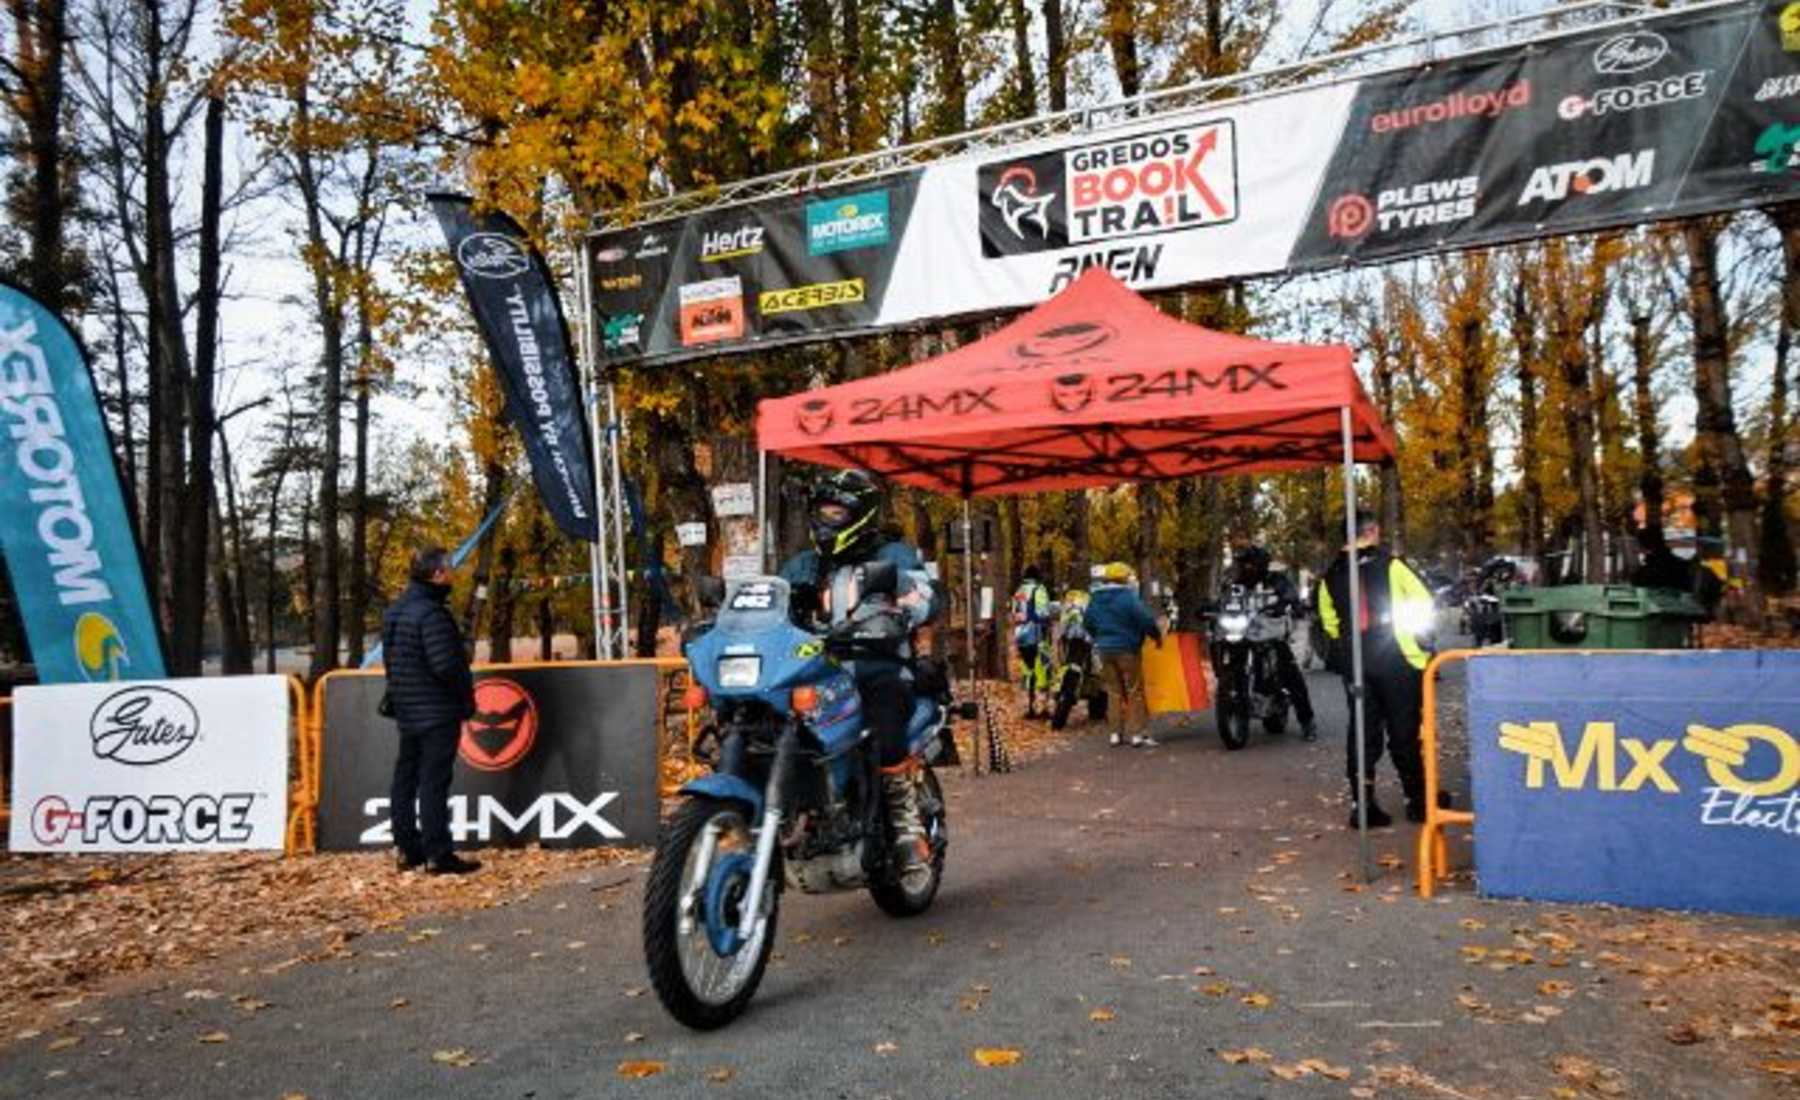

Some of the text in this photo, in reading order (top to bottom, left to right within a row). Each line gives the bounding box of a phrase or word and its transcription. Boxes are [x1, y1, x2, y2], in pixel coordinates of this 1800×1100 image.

[1370, 79, 1531, 134] eurolloyd
[1557, 72, 1707, 120] G-FORCE
[1072, 133, 1190, 172] GREDOS
[1072, 128, 1226, 217] BOOK
[1376, 176, 1480, 210] PLEWS
[1517, 148, 1656, 206] ATOM
[1376, 199, 1477, 231] TYRES
[702, 226, 764, 256] Hertz
[1106, 361, 1290, 402] 24MX
[848, 386, 1002, 426] 24MX
[95, 696, 196, 759] Gates
[31, 793, 256, 846] G-FORCE
[1701, 784, 1800, 833] Elect
